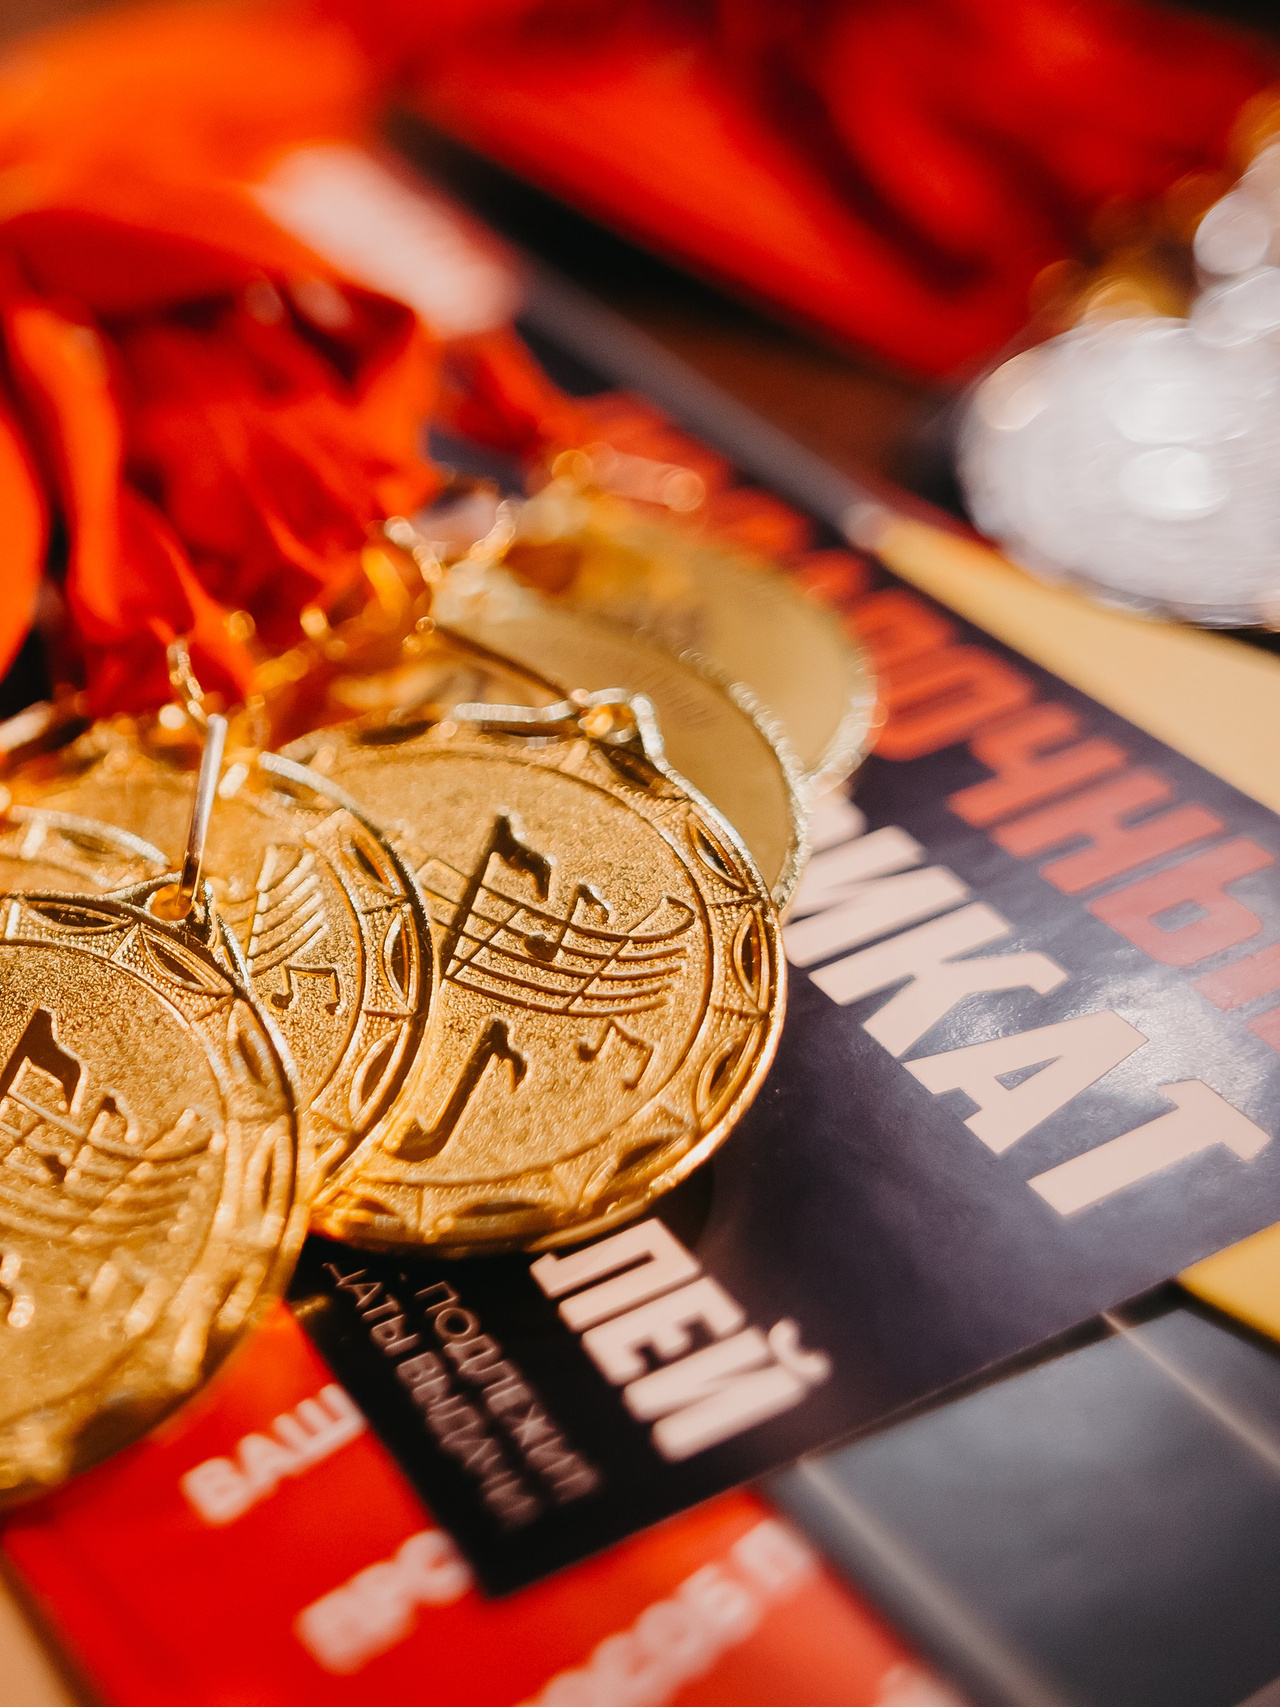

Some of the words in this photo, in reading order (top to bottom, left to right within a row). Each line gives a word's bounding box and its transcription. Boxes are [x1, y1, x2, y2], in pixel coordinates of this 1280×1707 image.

[783, 796, 1272, 1217] ИКАТ
[394, 1350, 540, 1525] ВЫДАЧИ
[413, 1279, 602, 1502] ПОДЛЕЖИТ
[529, 1217, 831, 1463] ЛЕЙ
